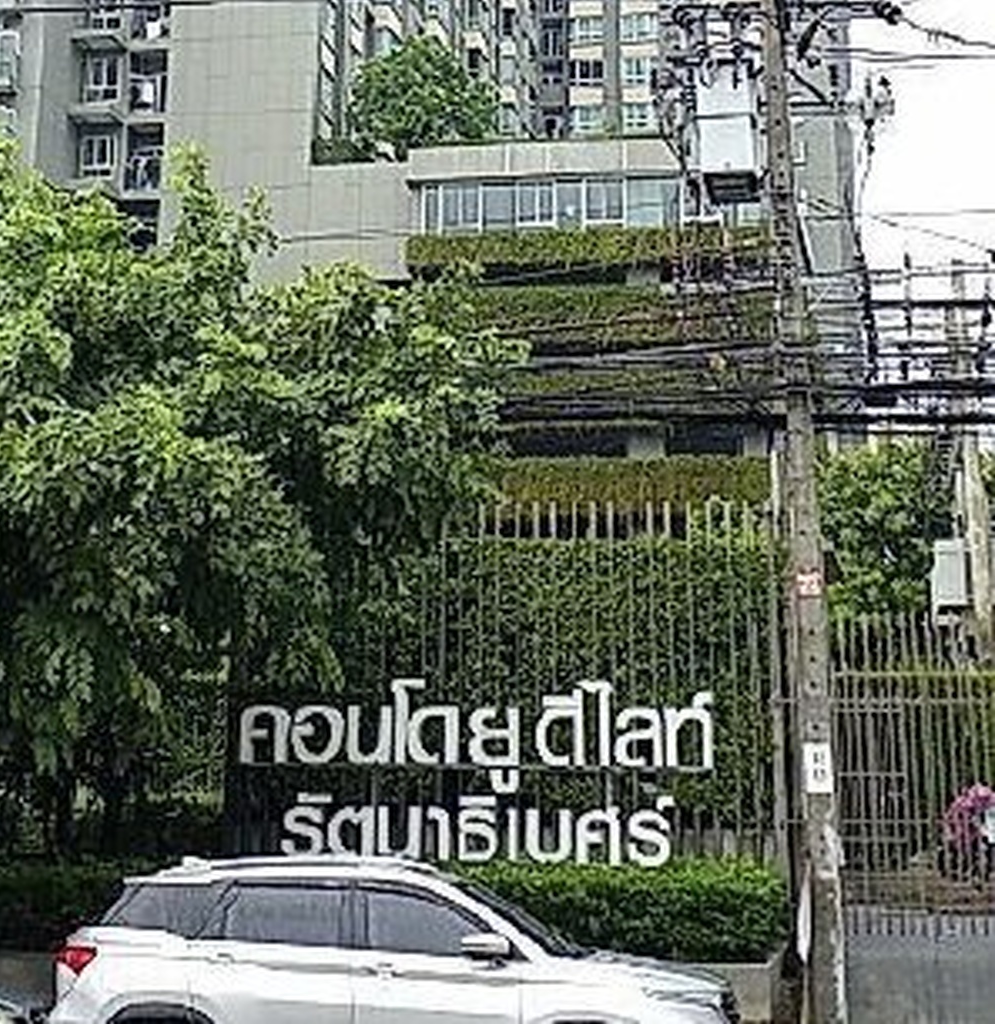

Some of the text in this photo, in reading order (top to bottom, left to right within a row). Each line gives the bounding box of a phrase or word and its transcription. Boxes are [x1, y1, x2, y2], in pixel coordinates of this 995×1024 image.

[280, 792, 675, 867] รัตนาธิเบศร์
